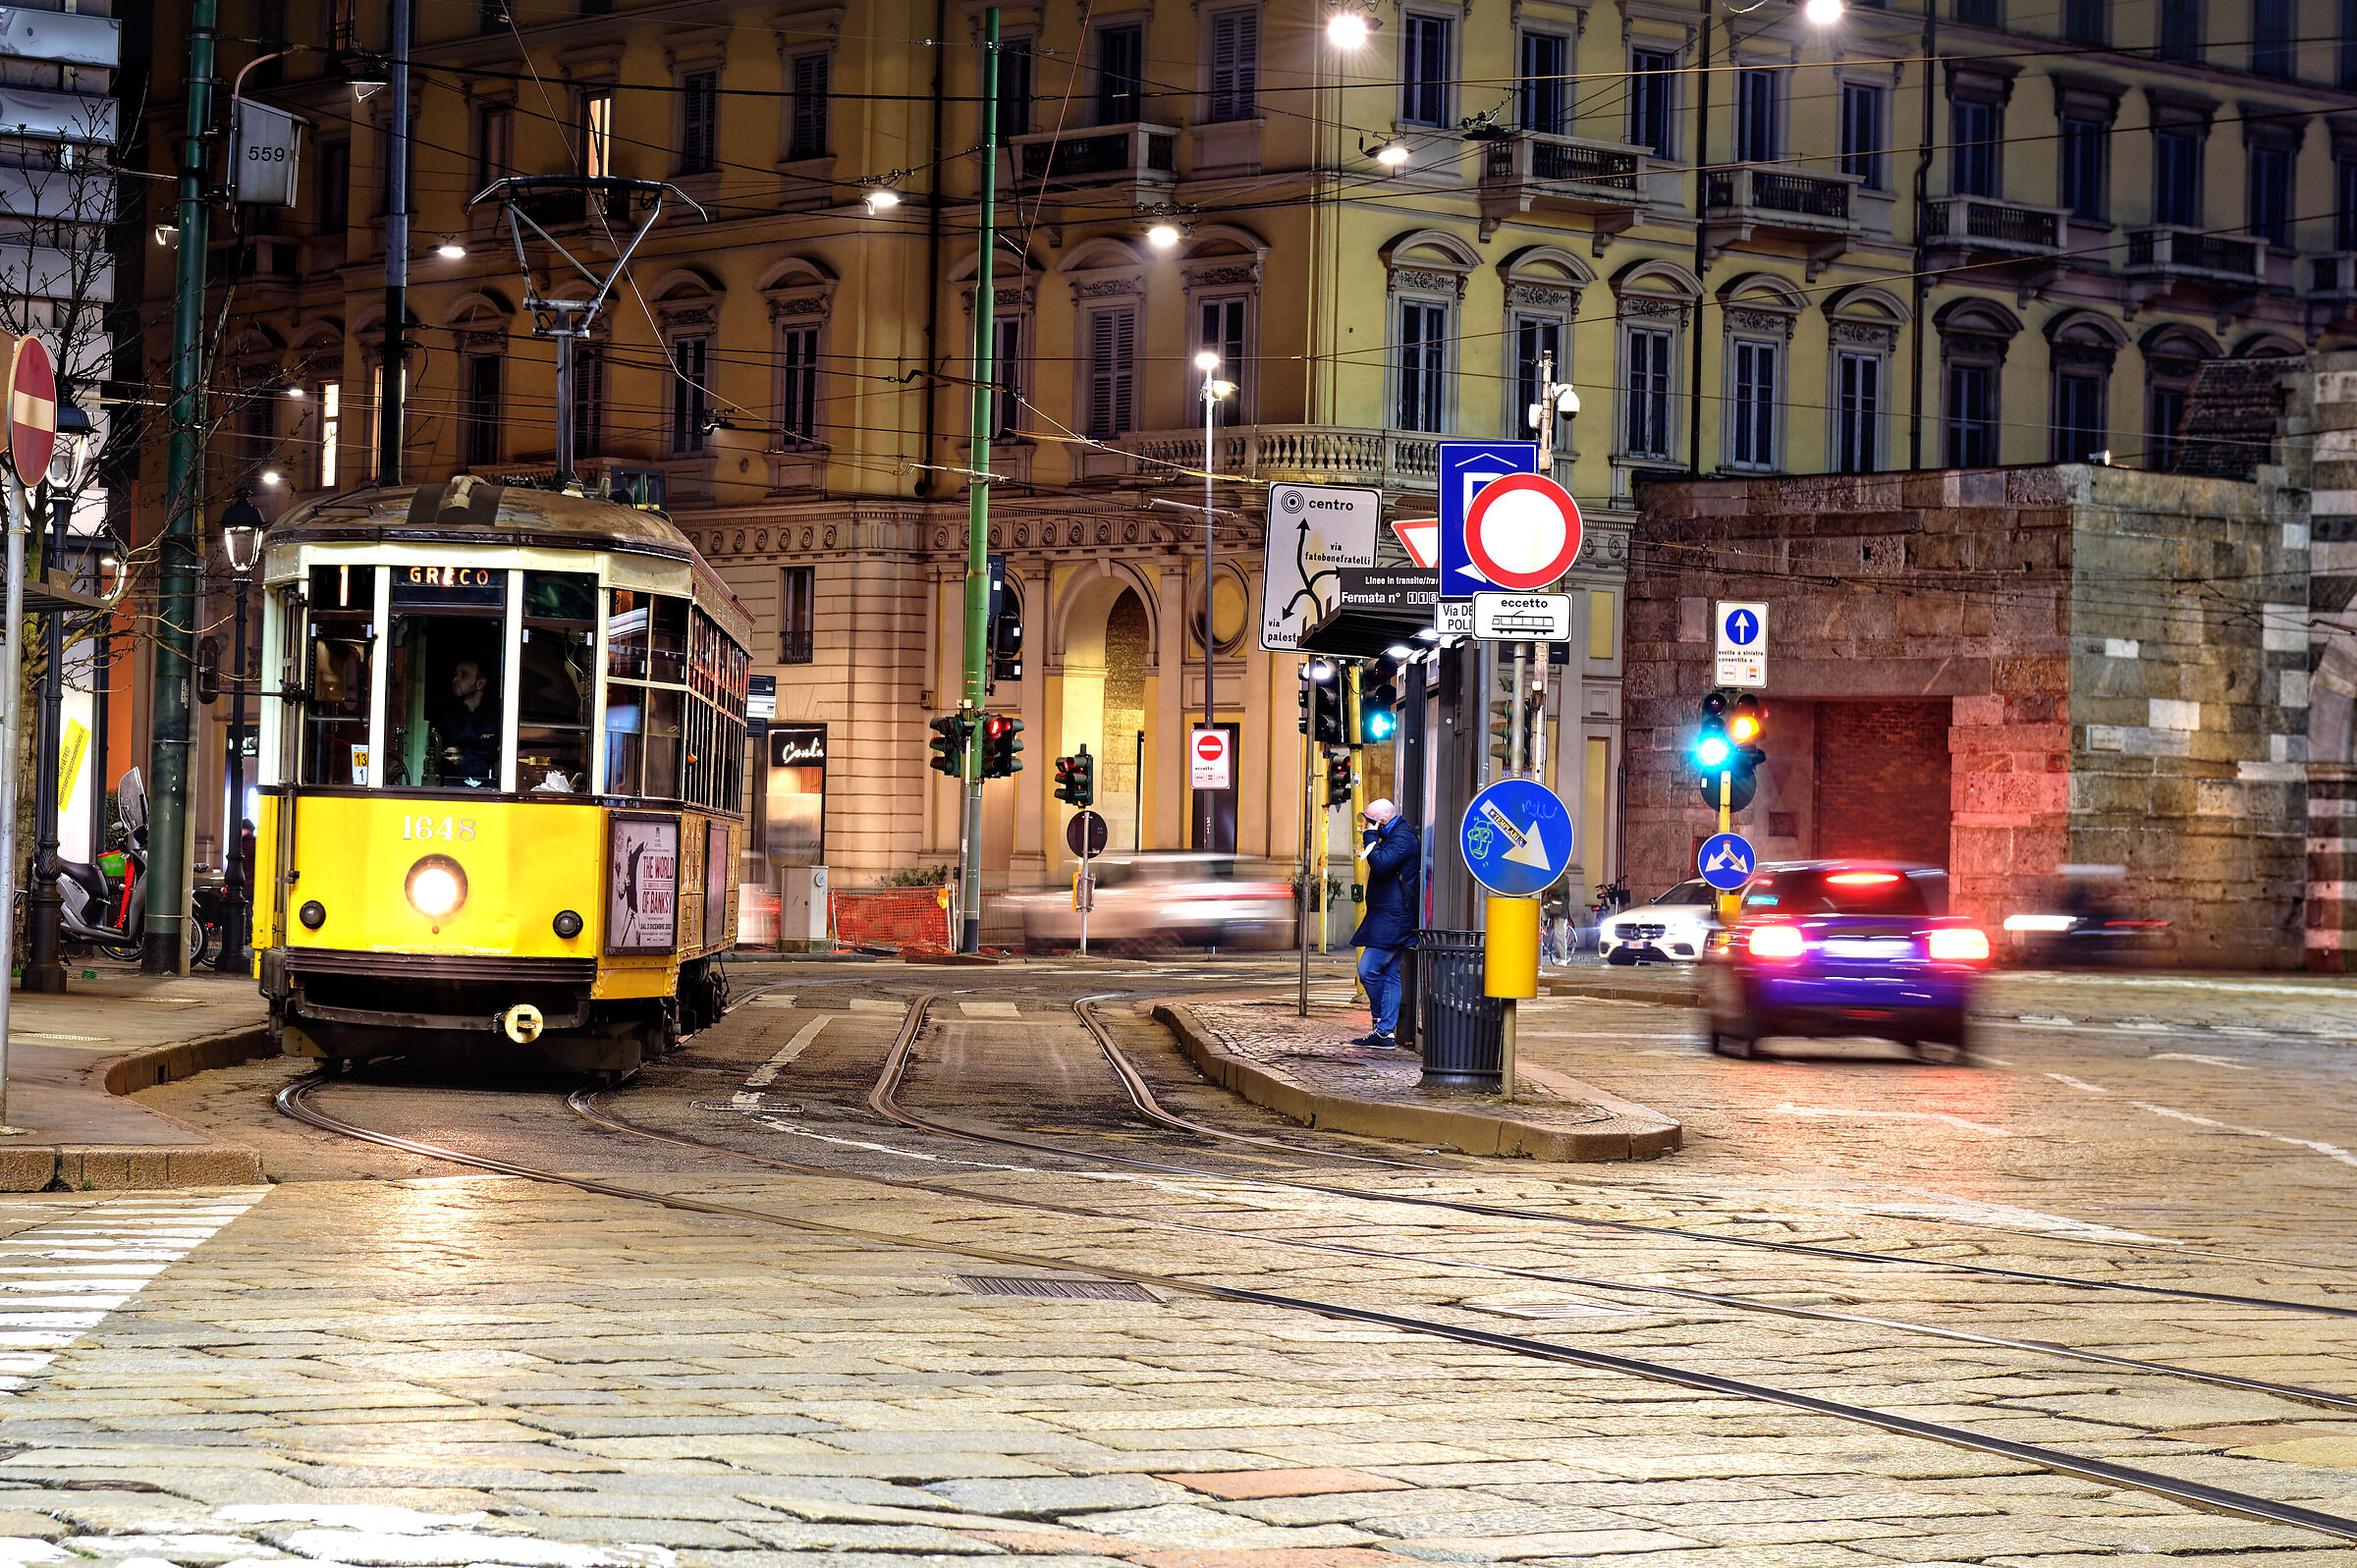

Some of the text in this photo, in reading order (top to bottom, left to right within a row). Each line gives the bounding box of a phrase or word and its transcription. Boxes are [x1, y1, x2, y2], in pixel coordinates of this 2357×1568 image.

[247, 145, 285, 162] 559
[1308, 499, 1354, 512] centro
[1330, 542, 1343, 551] via
[410, 566, 489, 586] GRECO
[1365, 575, 1386, 585] Linee
[1387, 575, 1395, 585] in
[1342, 591, 1386, 605] Fermata
[1388, 592, 1401, 604] n°
[1501, 599, 1549, 609] eccetto
[1443, 604, 1458, 617] Via
[1268, 619, 1281, 627] via
[356, 753, 367, 767] 13
[358, 769, 364, 782] 1
[403, 815, 476, 842] 1648
[1492, 812, 1520, 841] TEMPLARI
[643, 855, 675, 879] THE WORLD
[642, 891, 672, 914] OF BANKSY
